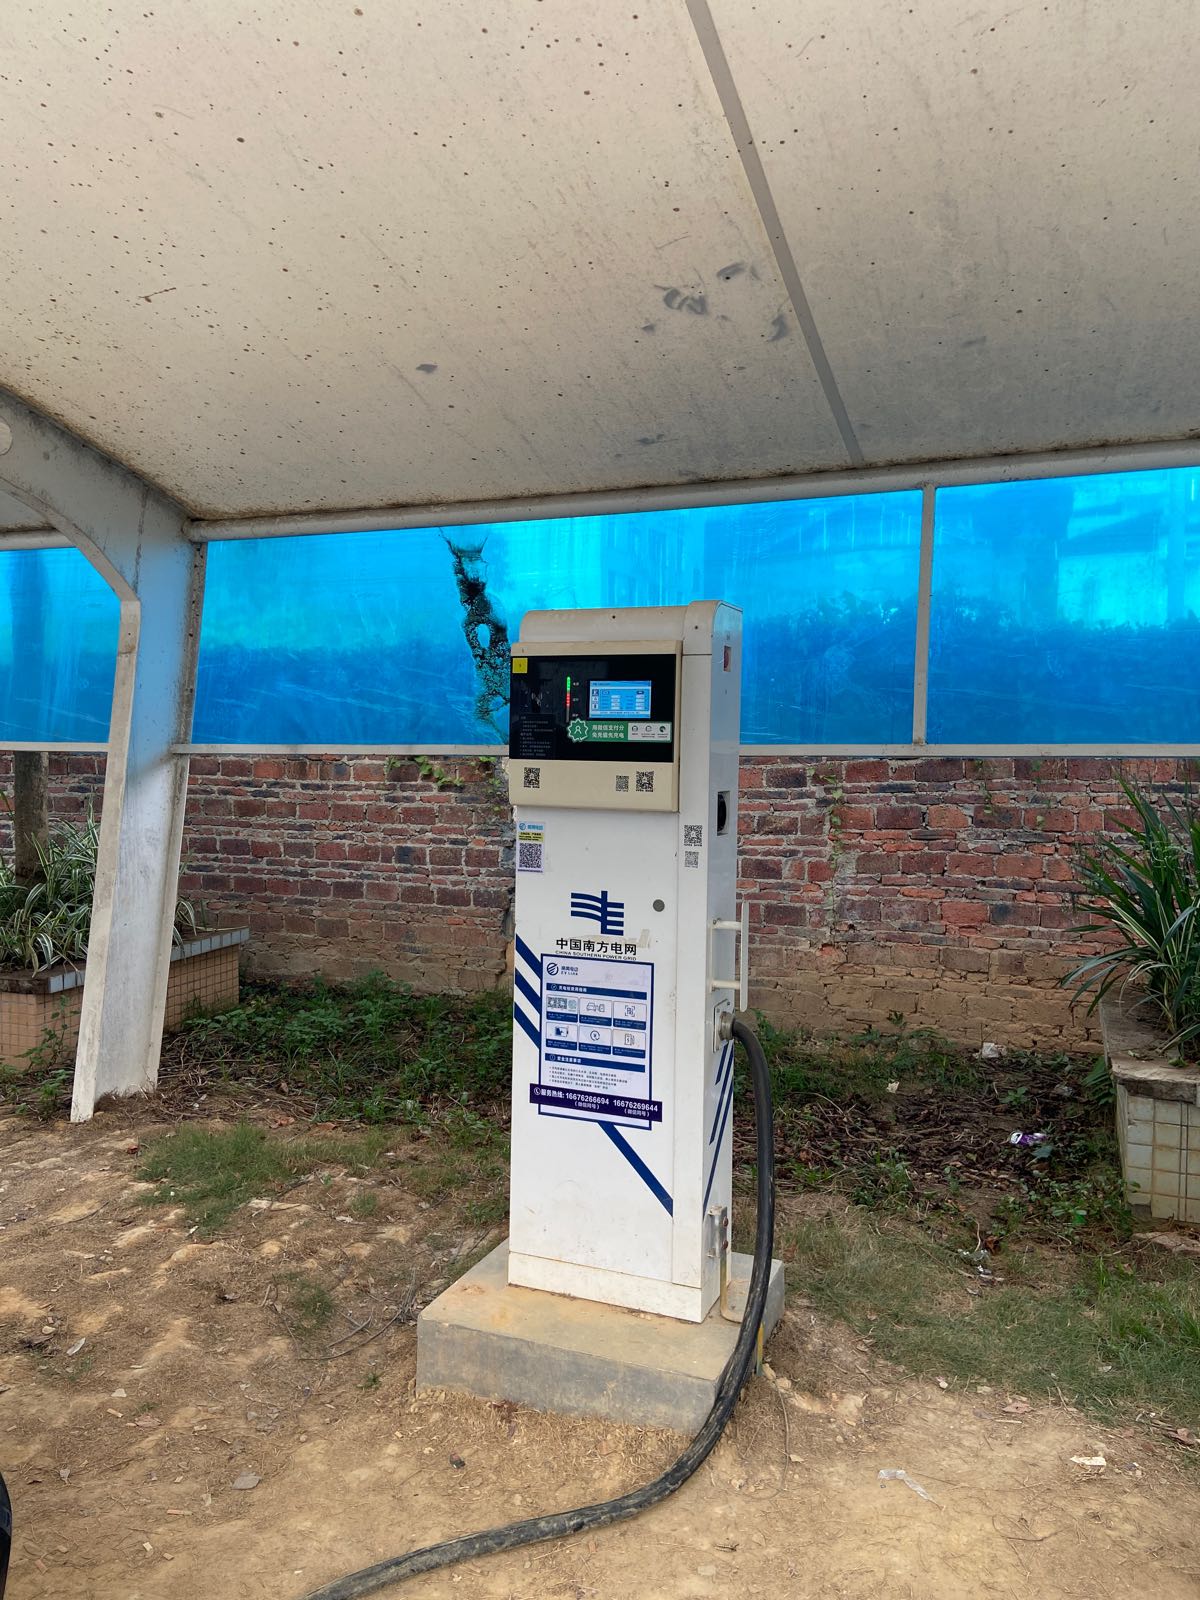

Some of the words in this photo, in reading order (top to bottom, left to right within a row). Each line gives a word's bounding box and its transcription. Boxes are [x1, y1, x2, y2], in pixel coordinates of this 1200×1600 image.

[556, 938, 637, 955] 中国南方电网
